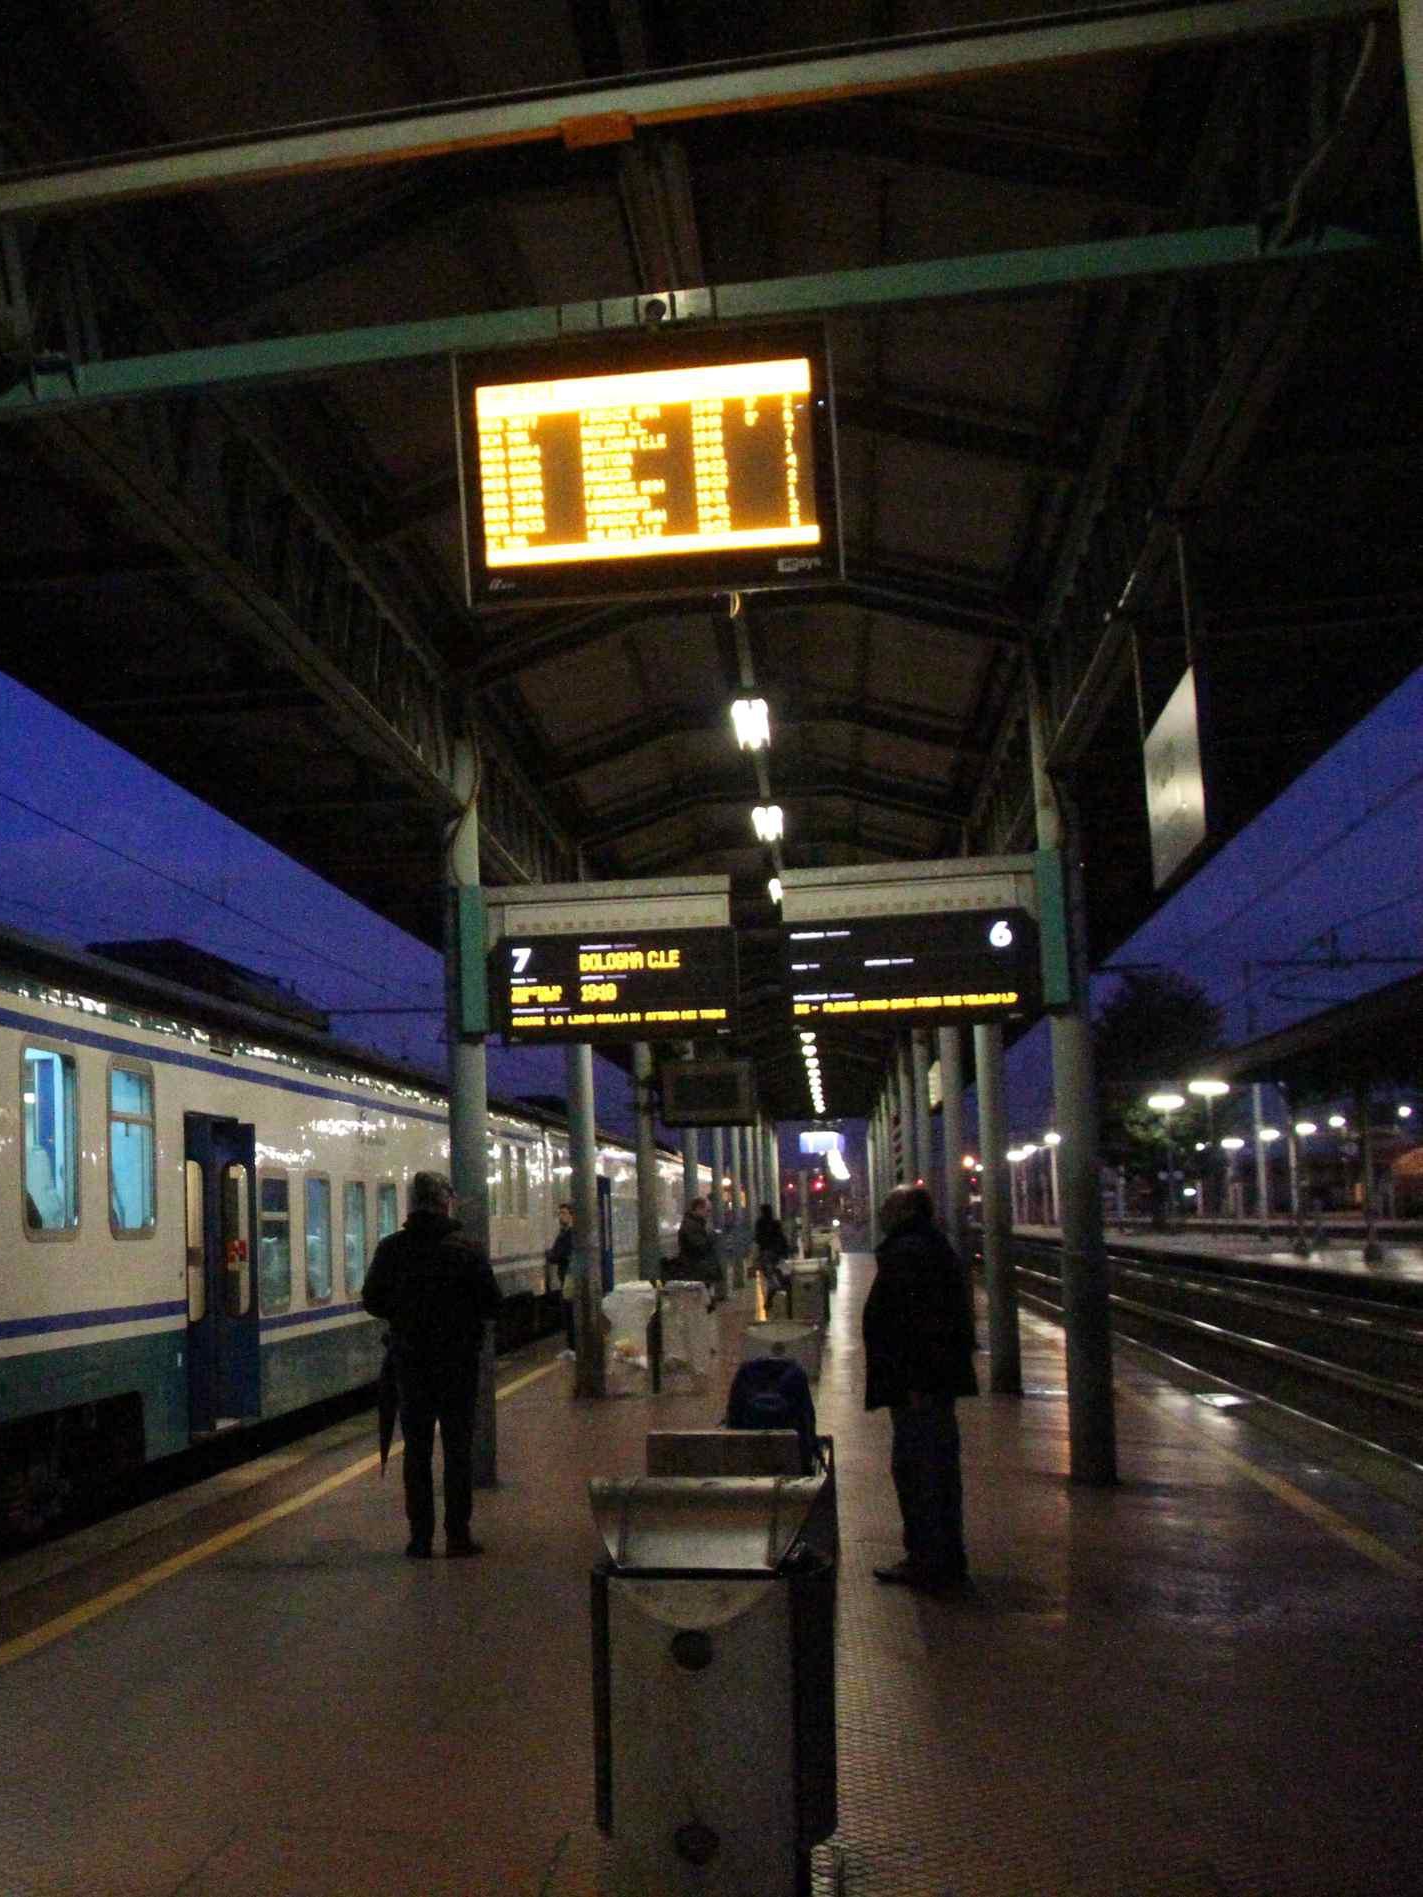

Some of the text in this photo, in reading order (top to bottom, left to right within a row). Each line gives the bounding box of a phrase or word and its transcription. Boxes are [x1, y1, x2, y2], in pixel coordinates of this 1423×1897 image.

[989, 920, 1013, 948] 6
[512, 948, 531, 972] 7
[579, 950, 680, 971] BOLOGNA C.LE
[551, 1016, 563, 1025] LA
